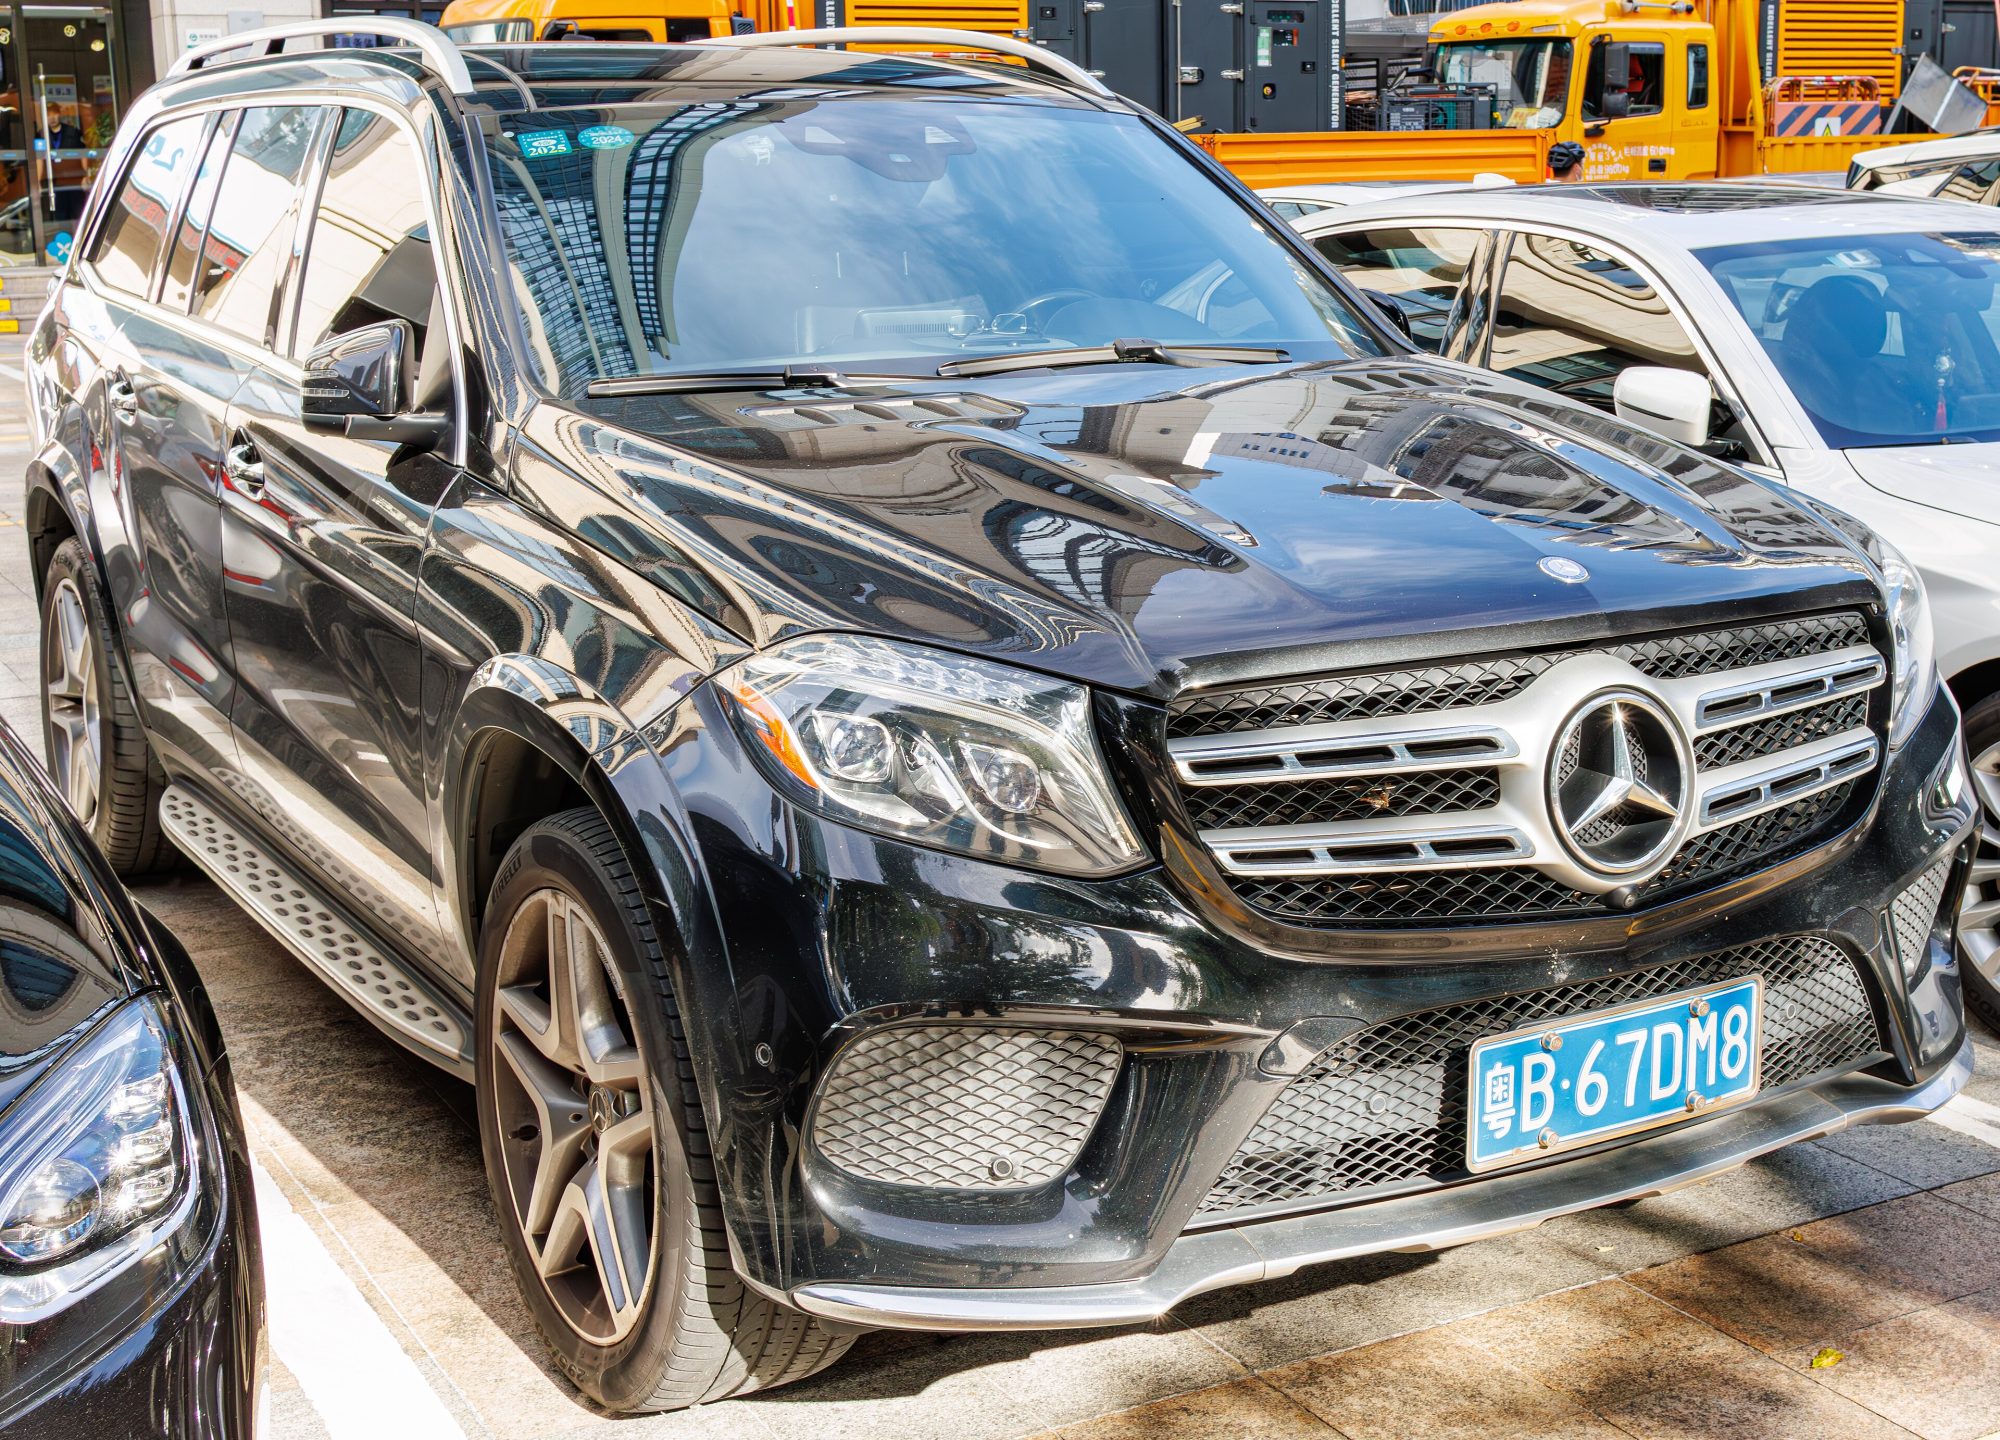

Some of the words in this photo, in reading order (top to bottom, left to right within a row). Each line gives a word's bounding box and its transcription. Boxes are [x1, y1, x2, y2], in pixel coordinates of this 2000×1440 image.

[1766, 4, 1775, 51] EXCELLENT
[1331, 38, 1340, 72] SILENT
[1331, 73, 1340, 128] GENERATOR
[527, 143, 567, 157] 2025
[591, 135, 623, 145] 2024
